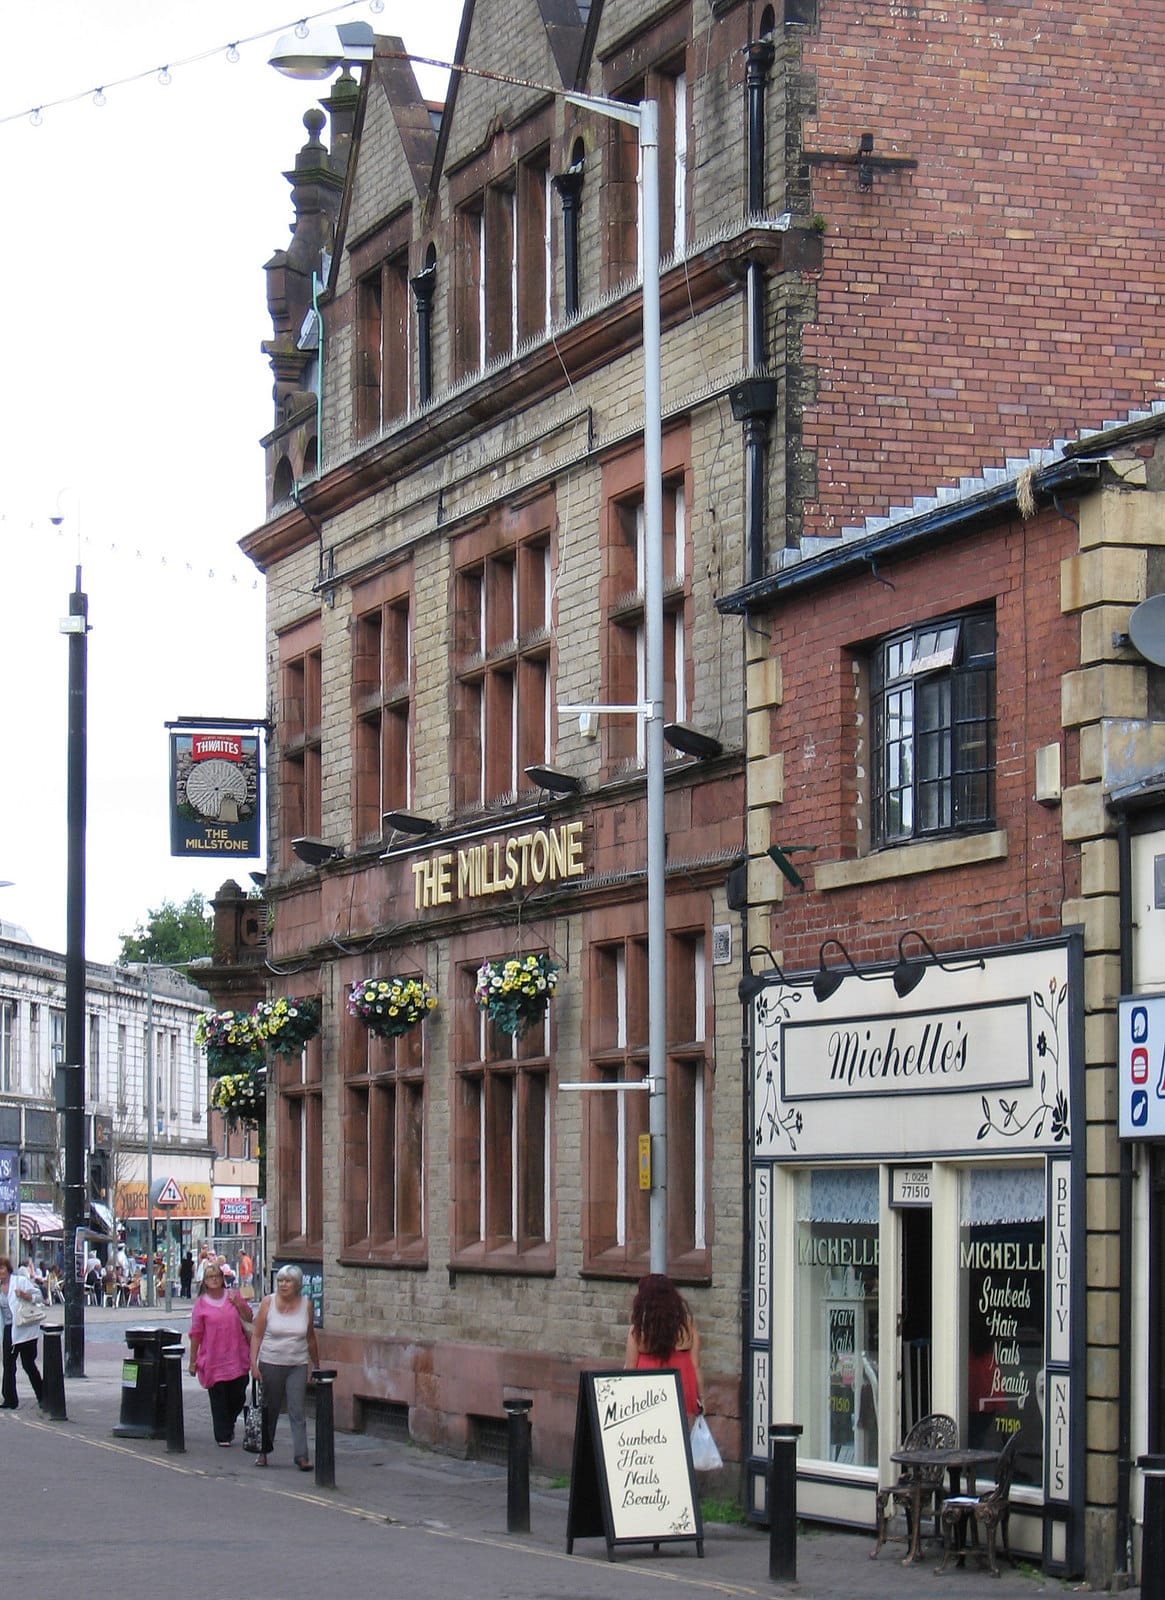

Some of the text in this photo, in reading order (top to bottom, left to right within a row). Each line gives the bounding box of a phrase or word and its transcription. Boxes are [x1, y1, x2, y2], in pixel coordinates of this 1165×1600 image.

[196, 740, 239, 755] THWAITES
[185, 839, 249, 850] MILLSTONE
[205, 829, 228, 839] THE
[412, 821, 584, 909] THE MILLSTONE
[828, 1020, 968, 1086] Michelle's
[184, 1187, 206, 1211] Store
[902, 1185, 930, 1198] 771510
[758, 1175, 767, 1330] SUNBEDS
[1056, 1177, 1068, 1333] BEAUTY
[979, 1275, 1031, 1313] Sunbeds
[986, 1310, 1017, 1337] Hair
[990, 1340, 1020, 1370] Nails
[757, 1358, 766, 1445] HAIR
[991, 1369, 1030, 1404] Beauty
[604, 1388, 668, 1426] Michelle's
[618, 1429, 668, 1447] Sunbeds
[1055, 1383, 1066, 1490] NAILS
[617, 1449, 655, 1471] Hair
[624, 1468, 660, 1488] Nails
